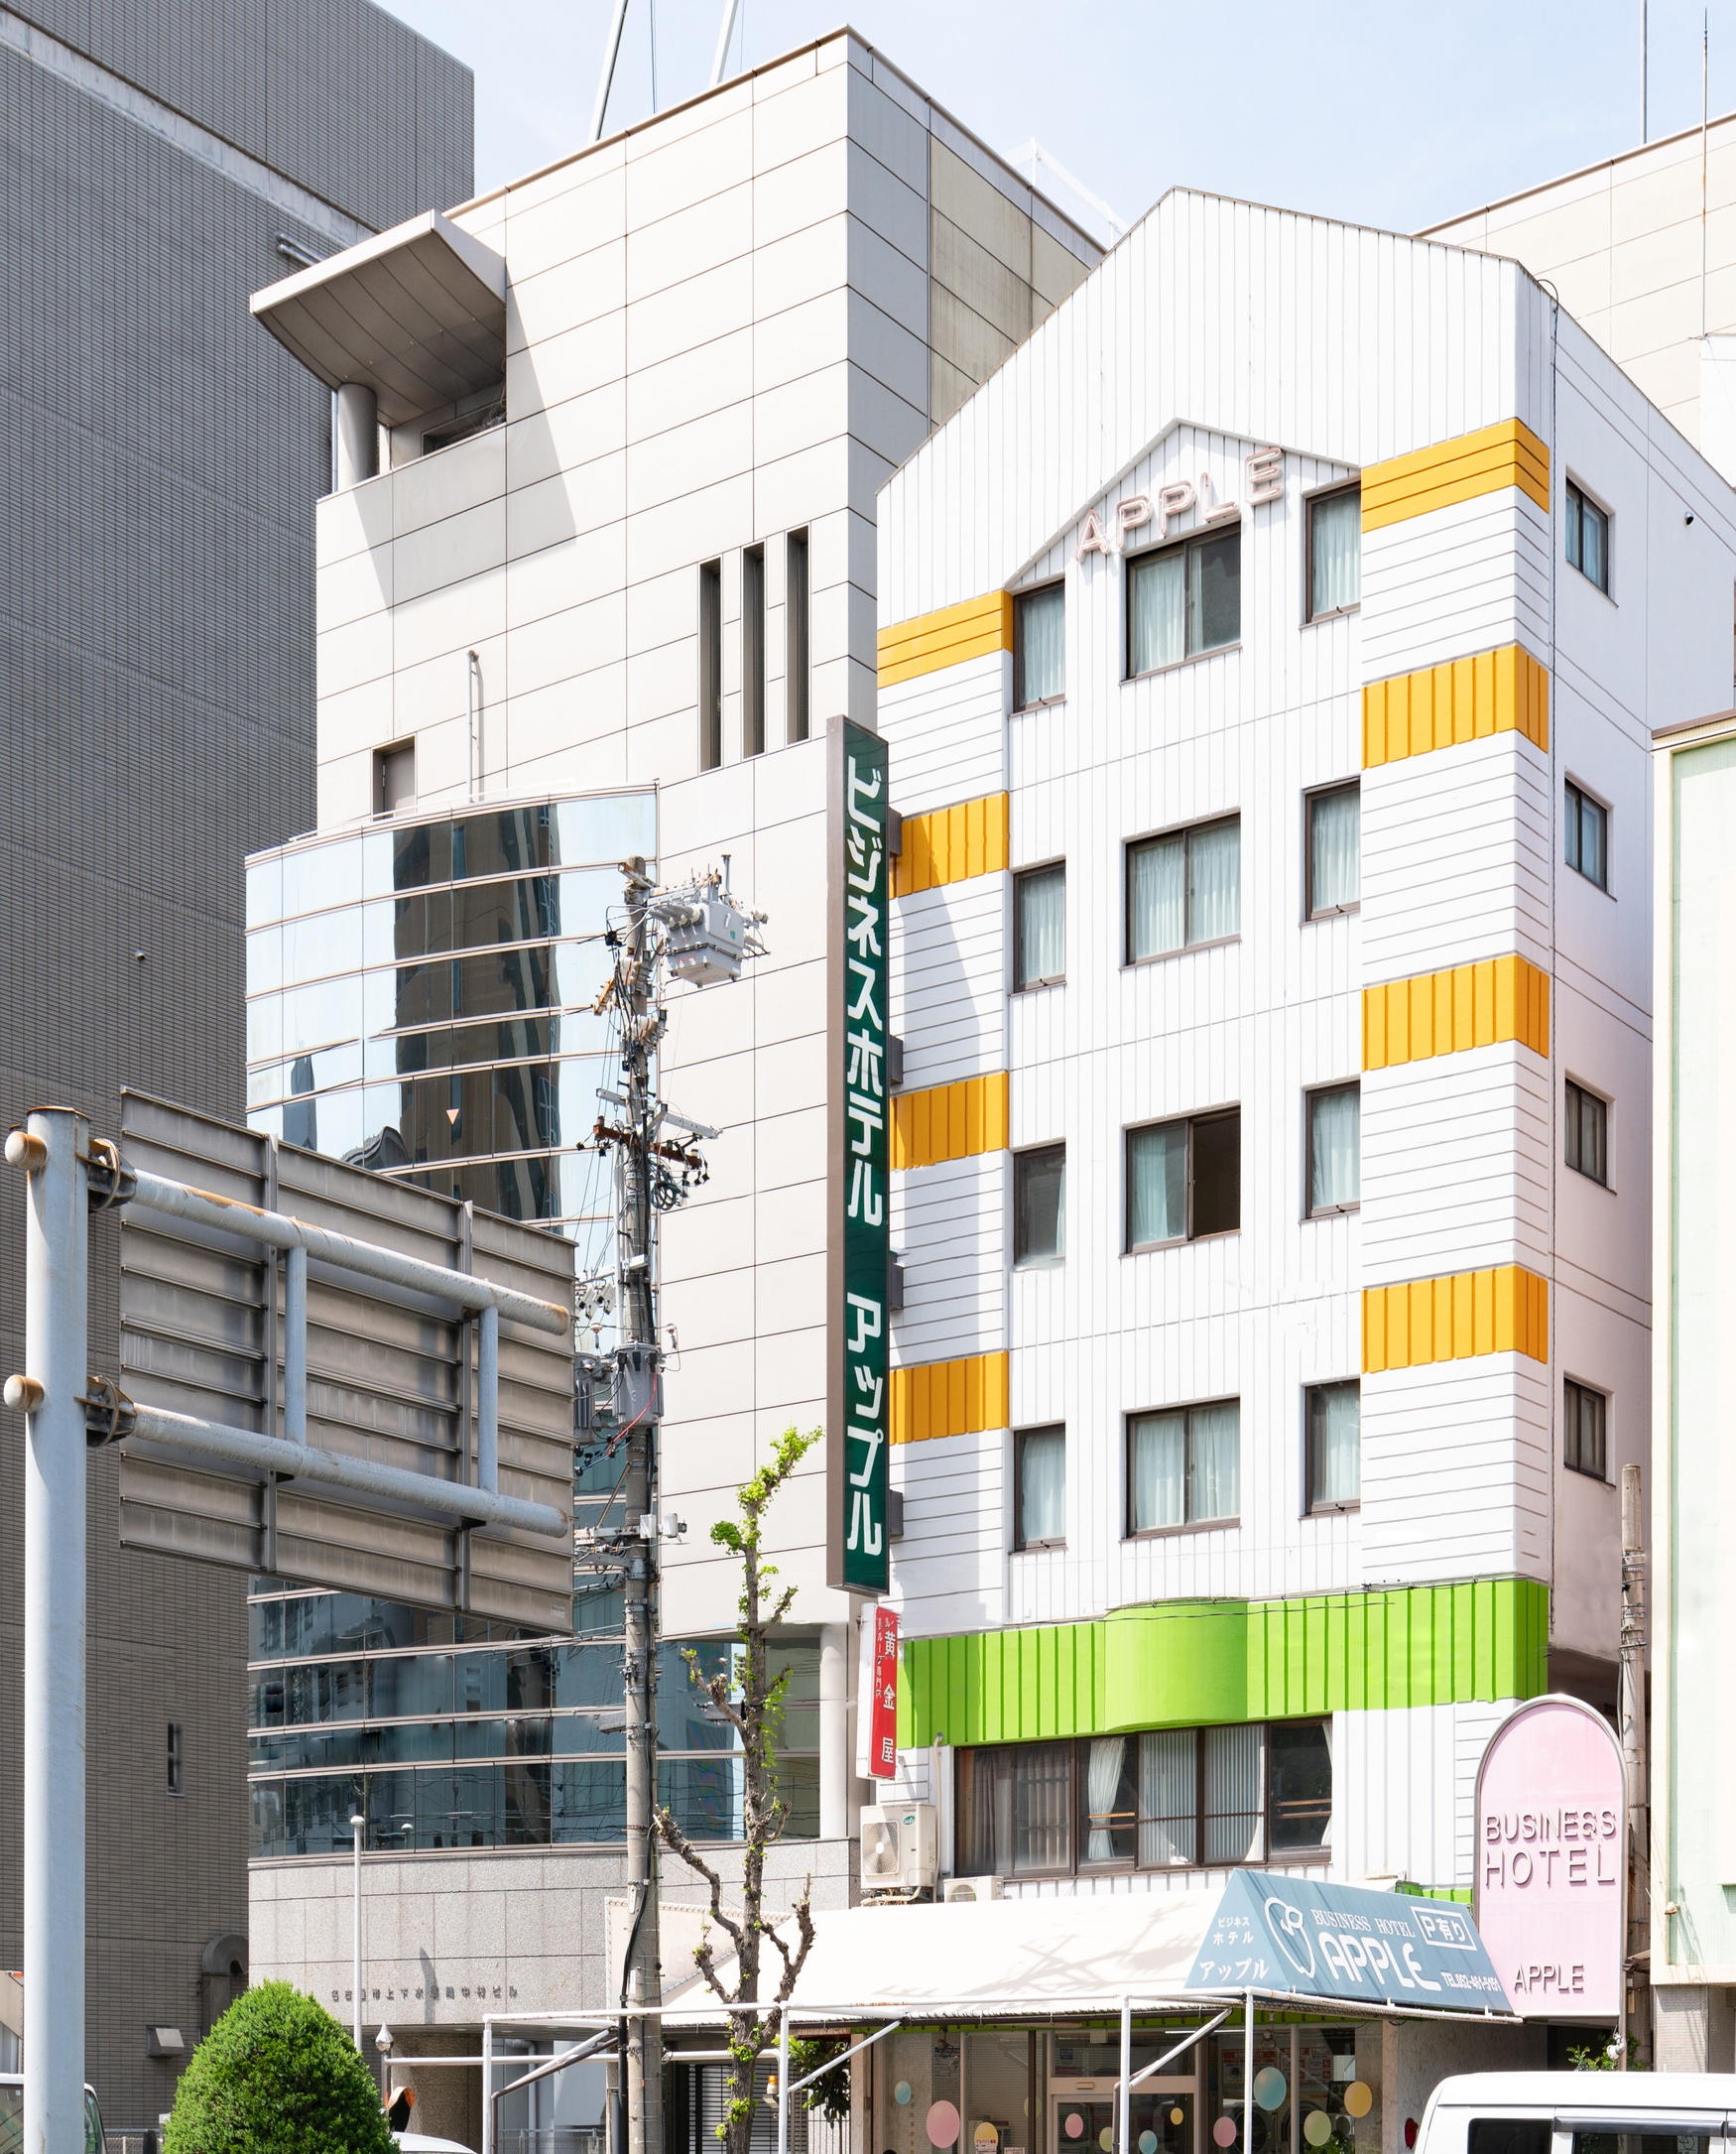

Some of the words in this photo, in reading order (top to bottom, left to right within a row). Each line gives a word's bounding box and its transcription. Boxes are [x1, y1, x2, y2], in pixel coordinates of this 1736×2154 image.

[1075, 446, 1283, 563] APPLE
[847, 755, 884, 1226] ビジネスホテル
[846, 1292, 884, 1556] アップル
[1486, 1807, 1617, 1843] BUSINESS
[1485, 1842, 1616, 1890] HOTEL
[1213, 1931, 1254, 1946] ホテル
[1218, 1916, 1250, 1928] ビジネス
[1310, 1909, 1371, 1933] BUSINESS
[1374, 1918, 1417, 1938] HOTEL
[1420, 1915, 1466, 1943] P有り
[1199, 1958, 1270, 1982] アップル
[1317, 1932, 1442, 1991] APPLE
[1513, 1964, 1586, 1994] APPLE
